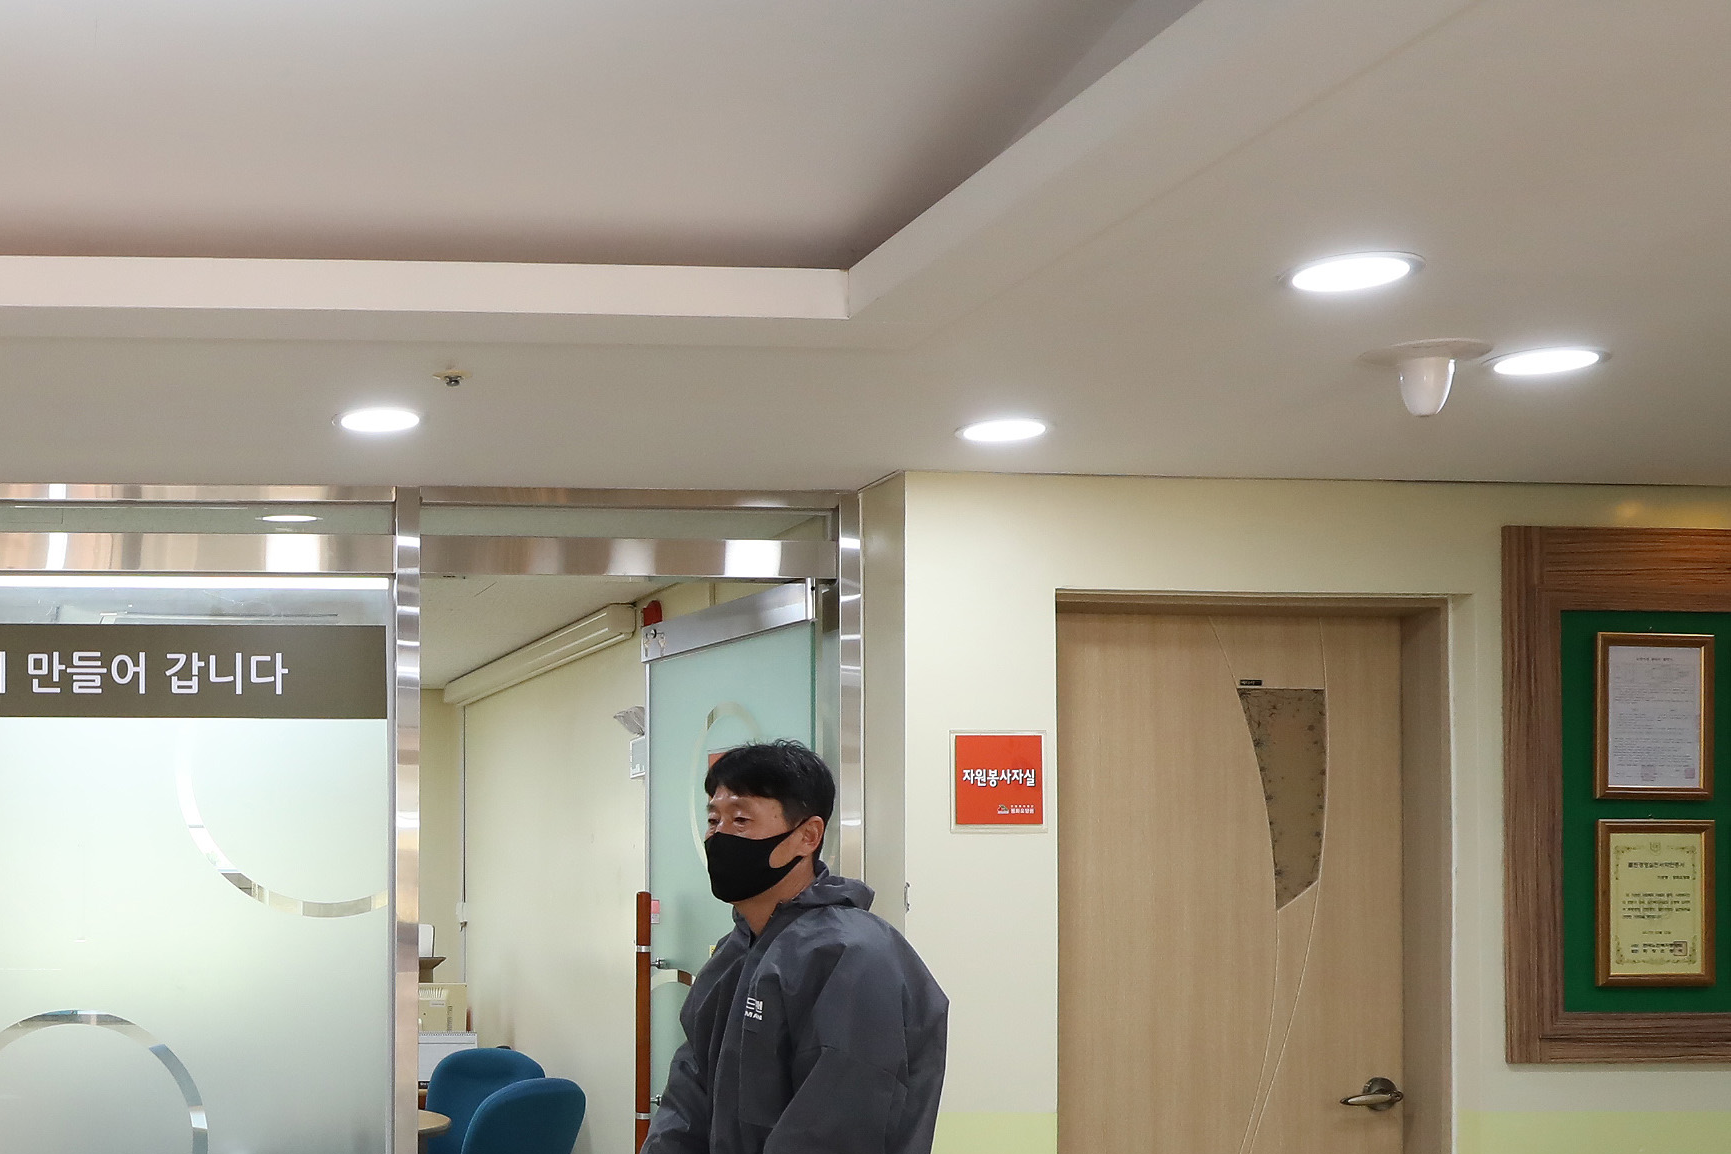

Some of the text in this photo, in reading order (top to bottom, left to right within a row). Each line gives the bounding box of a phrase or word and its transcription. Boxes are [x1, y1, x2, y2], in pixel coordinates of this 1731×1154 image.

[27, 651, 146, 695] 만들어
[165, 652, 289, 695] 갑니다
[962, 768, 1036, 788] 자원봉사자실
